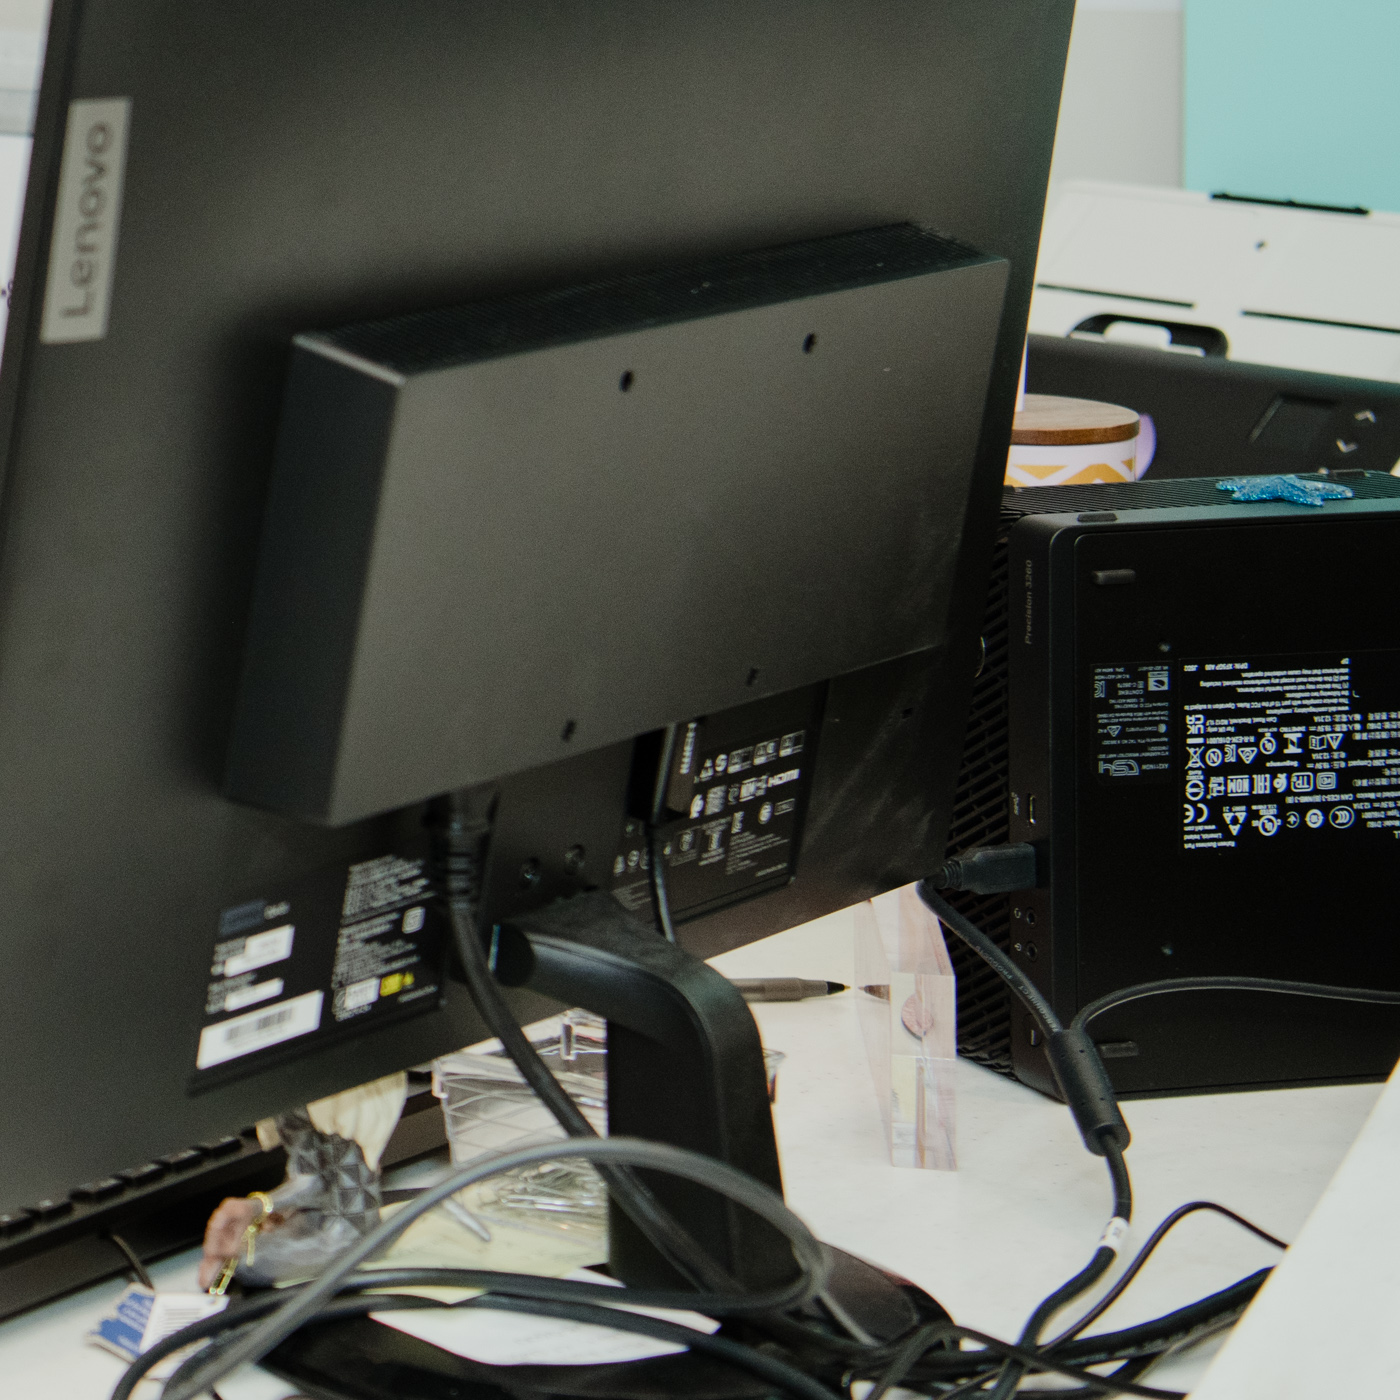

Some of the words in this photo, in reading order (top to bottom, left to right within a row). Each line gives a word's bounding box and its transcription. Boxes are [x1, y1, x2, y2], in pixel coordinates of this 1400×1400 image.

[59, 121, 114, 319] Lenovo
[1023, 559, 1033, 590] 3260
[1023, 592, 1033, 645] Precision
[1186, 714, 1204, 725] CA
[1187, 725, 1204, 734] UK
